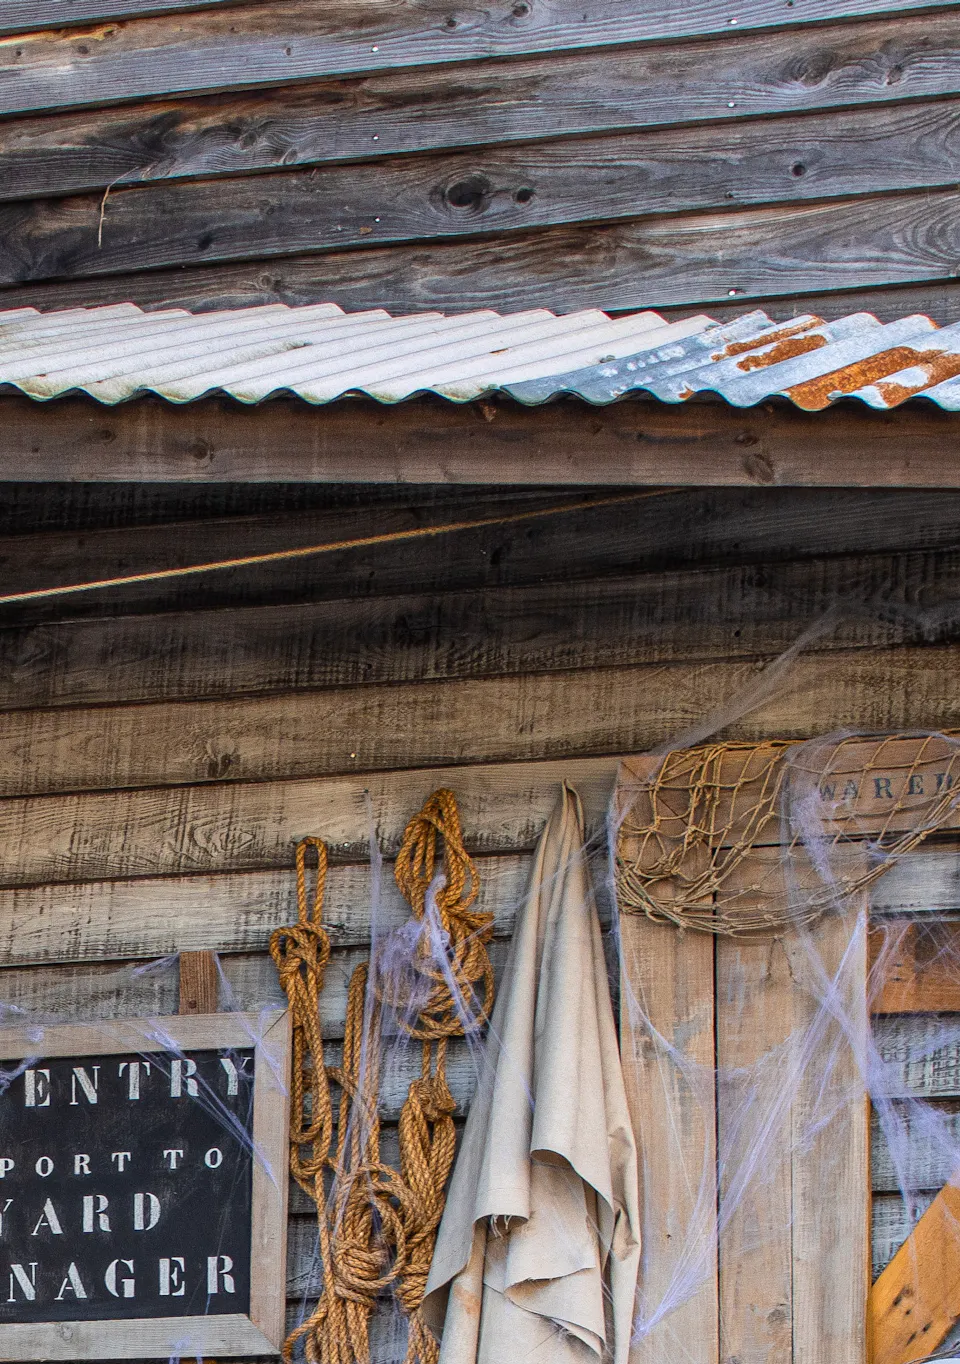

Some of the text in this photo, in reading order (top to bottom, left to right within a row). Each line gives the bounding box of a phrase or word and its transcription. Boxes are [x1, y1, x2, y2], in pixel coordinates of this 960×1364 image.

[25, 1056, 252, 1107] ENTRY
[163, 1148, 223, 1170] TO
[7, 1255, 236, 1302] NAGER
